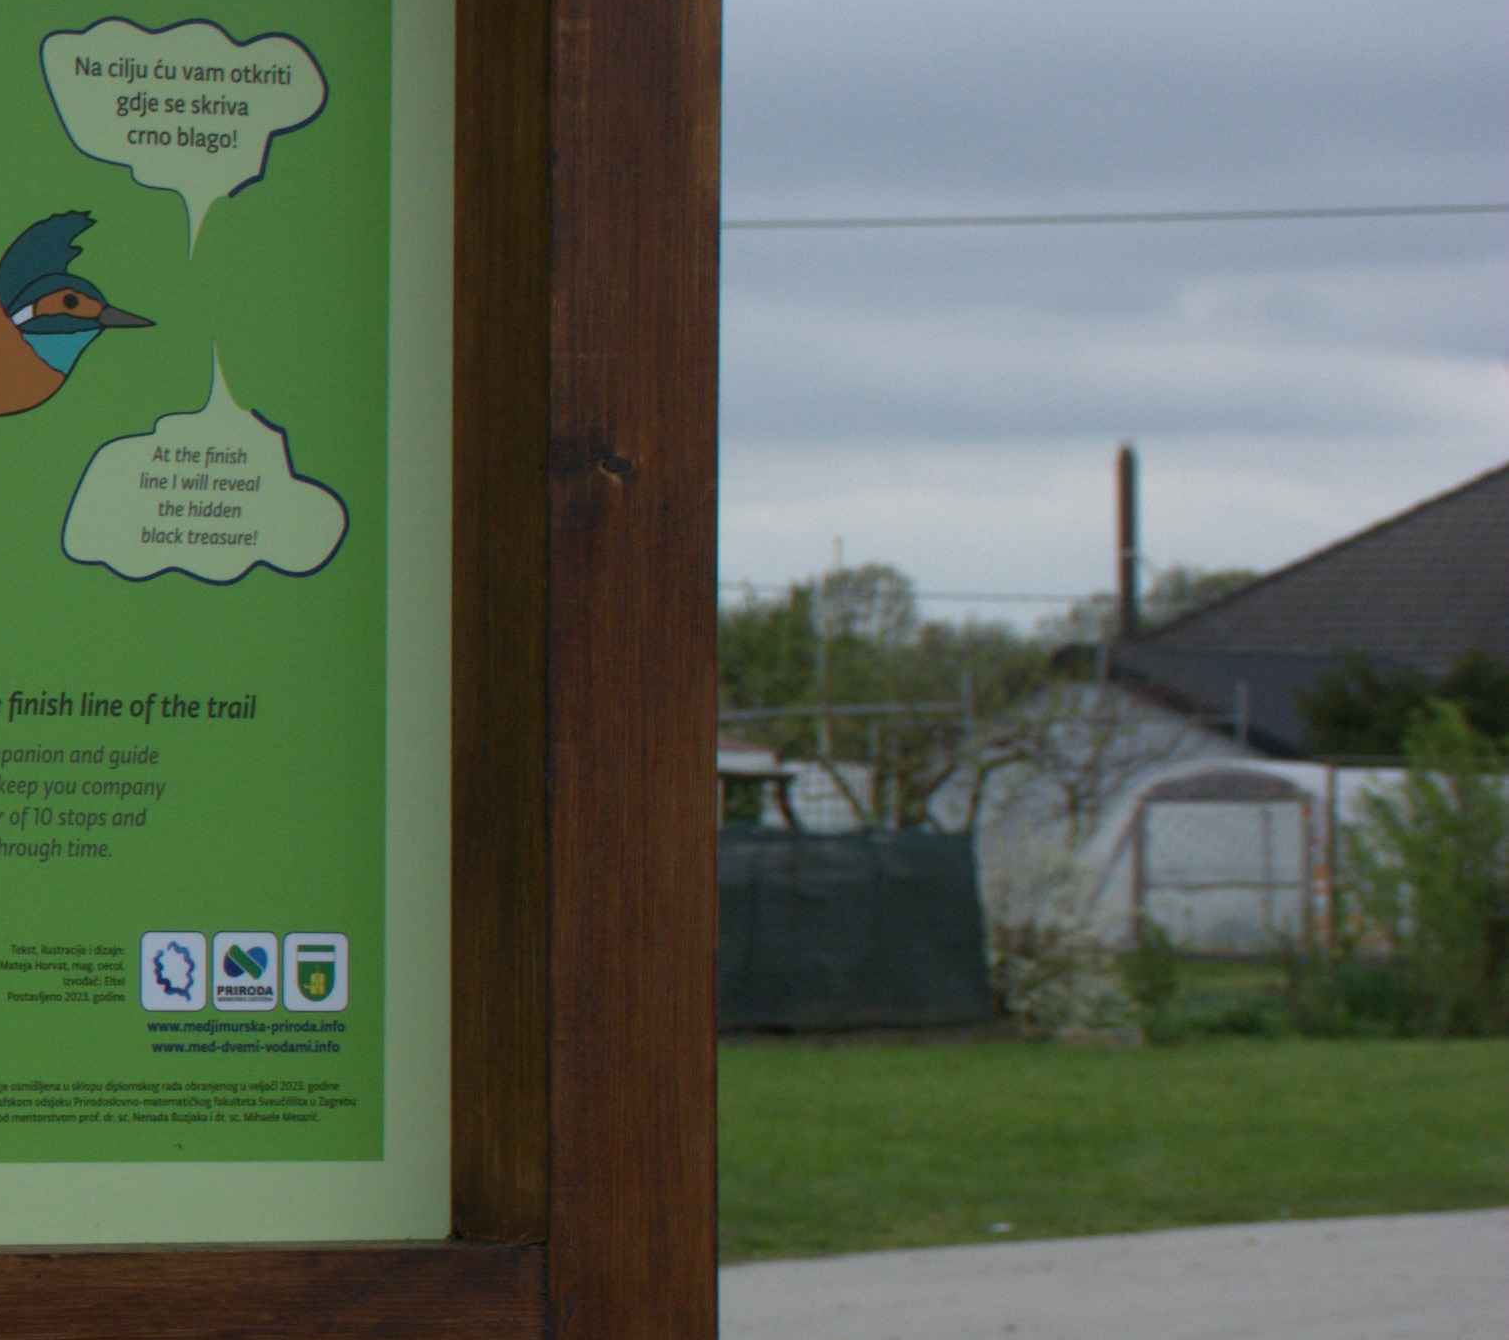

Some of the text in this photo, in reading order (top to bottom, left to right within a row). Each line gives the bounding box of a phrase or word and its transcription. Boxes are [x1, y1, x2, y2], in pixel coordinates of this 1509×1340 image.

[74, 55, 291, 85] Na cilju ću vam otkriti
[115, 90, 249, 118] gdje se skriva
[126, 125, 238, 154] crno blago!
[151, 445, 248, 469] At the finish
[139, 471, 169, 490] line
[180, 472, 210, 490] will
[212, 474, 262, 492] reveal
[157, 499, 243, 519] the hidden
[140, 525, 259, 547] black treasure!
[7, 689, 74, 723] finish
[79, 690, 124, 718] line
[128, 691, 158, 725] of
[160, 692, 201, 719] the
[206, 693, 257, 720] trail
[68, 744, 106, 765] and
[108, 744, 161, 770] guide
[43, 779, 77, 800] you
[80, 779, 167, 801] company
[216, 985, 274, 996] PRIRODA
[146, 1018, 347, 1036] www.medjimurska-priroda.info
[150, 1039, 341, 1053] www.med-dvemi-vodami.info
